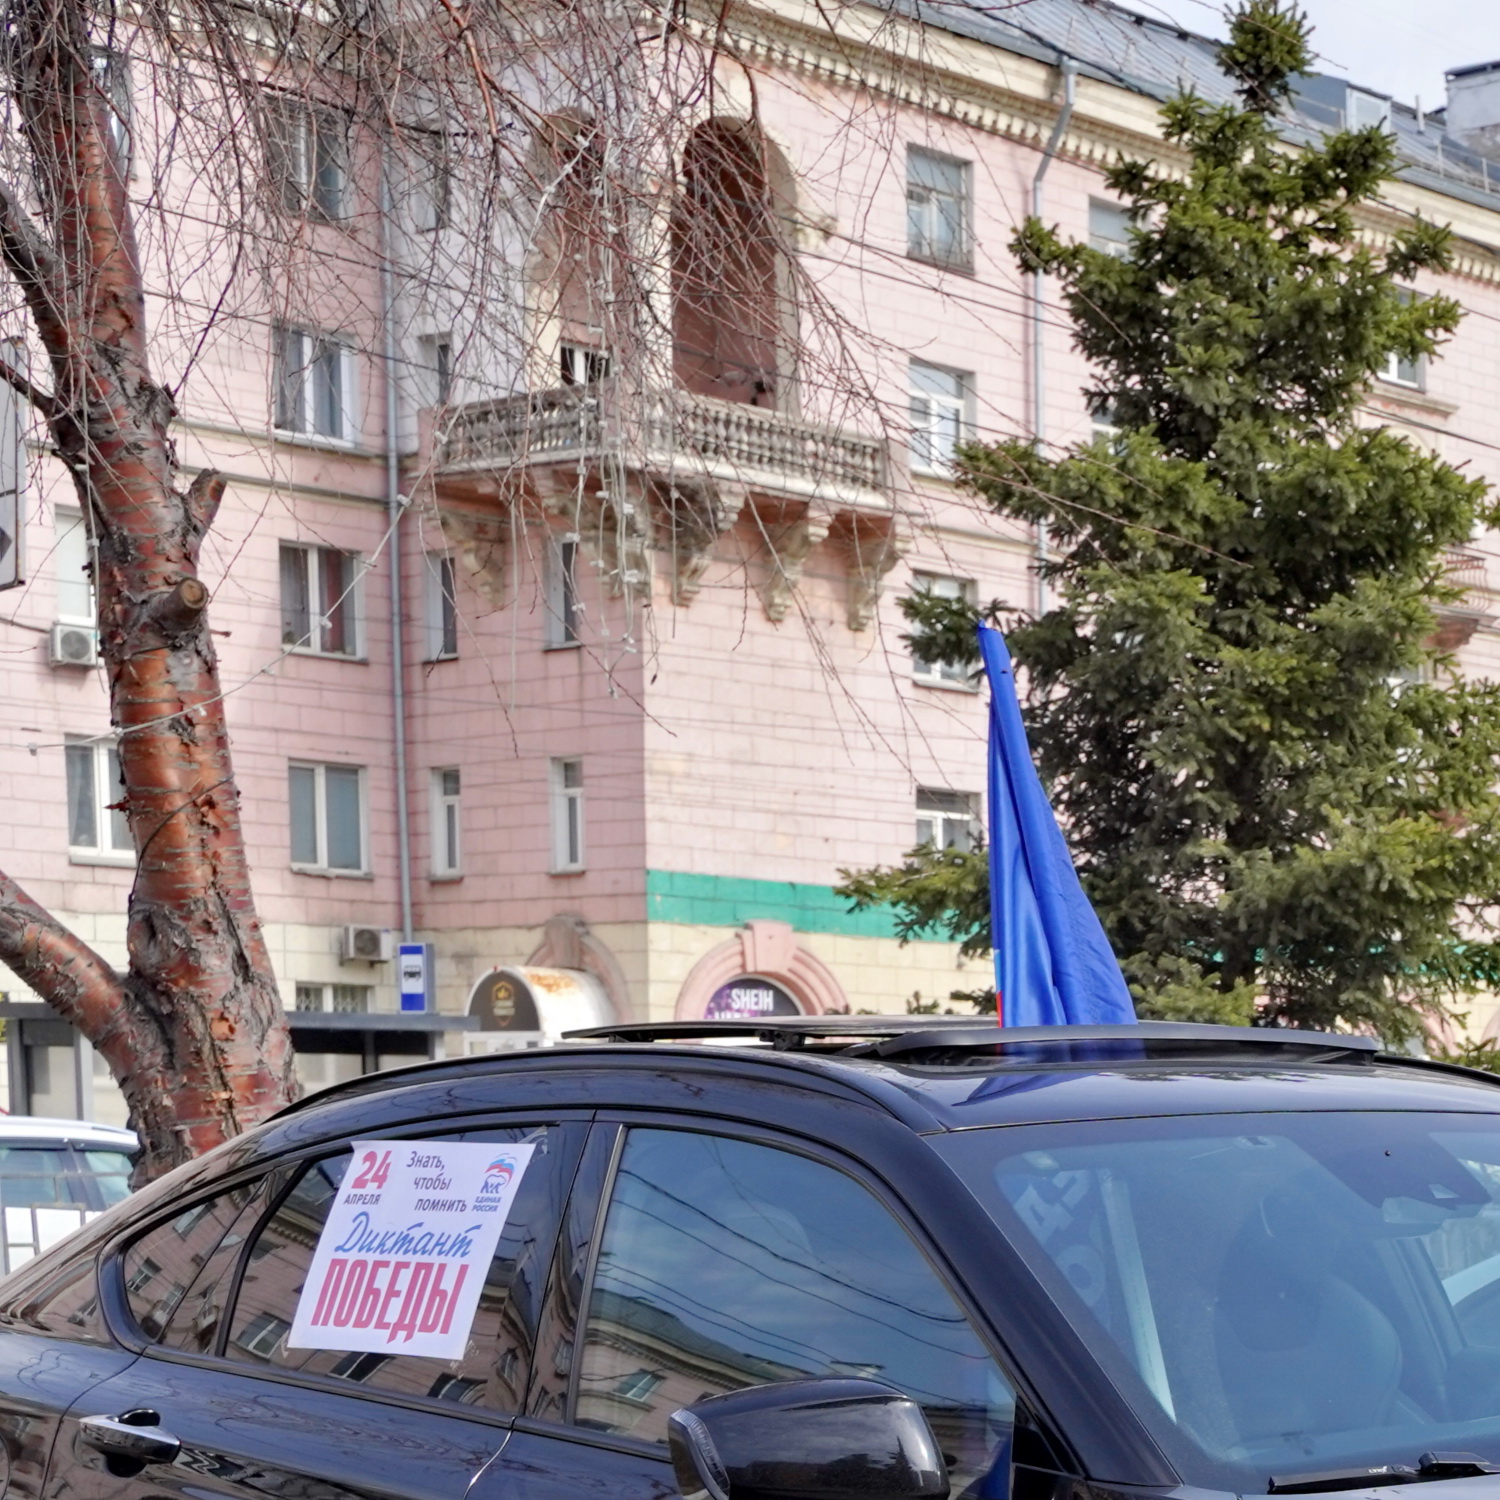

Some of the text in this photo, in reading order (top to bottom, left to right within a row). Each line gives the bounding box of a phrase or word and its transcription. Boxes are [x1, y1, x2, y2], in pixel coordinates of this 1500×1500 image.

[406, 1151, 445, 1170] Знать,
[352, 1151, 392, 1190] 24
[413, 1173, 452, 1190] чтобы
[343, 1193, 382, 1205] АПРЕЛЯ
[474, 1196, 503, 1204] ЕДИНАЯ
[471, 1204, 499, 1213] РОССИЯ
[334, 1211, 484, 1259] Диктант
[310, 1258, 470, 1344] ПОБЕДЫ
